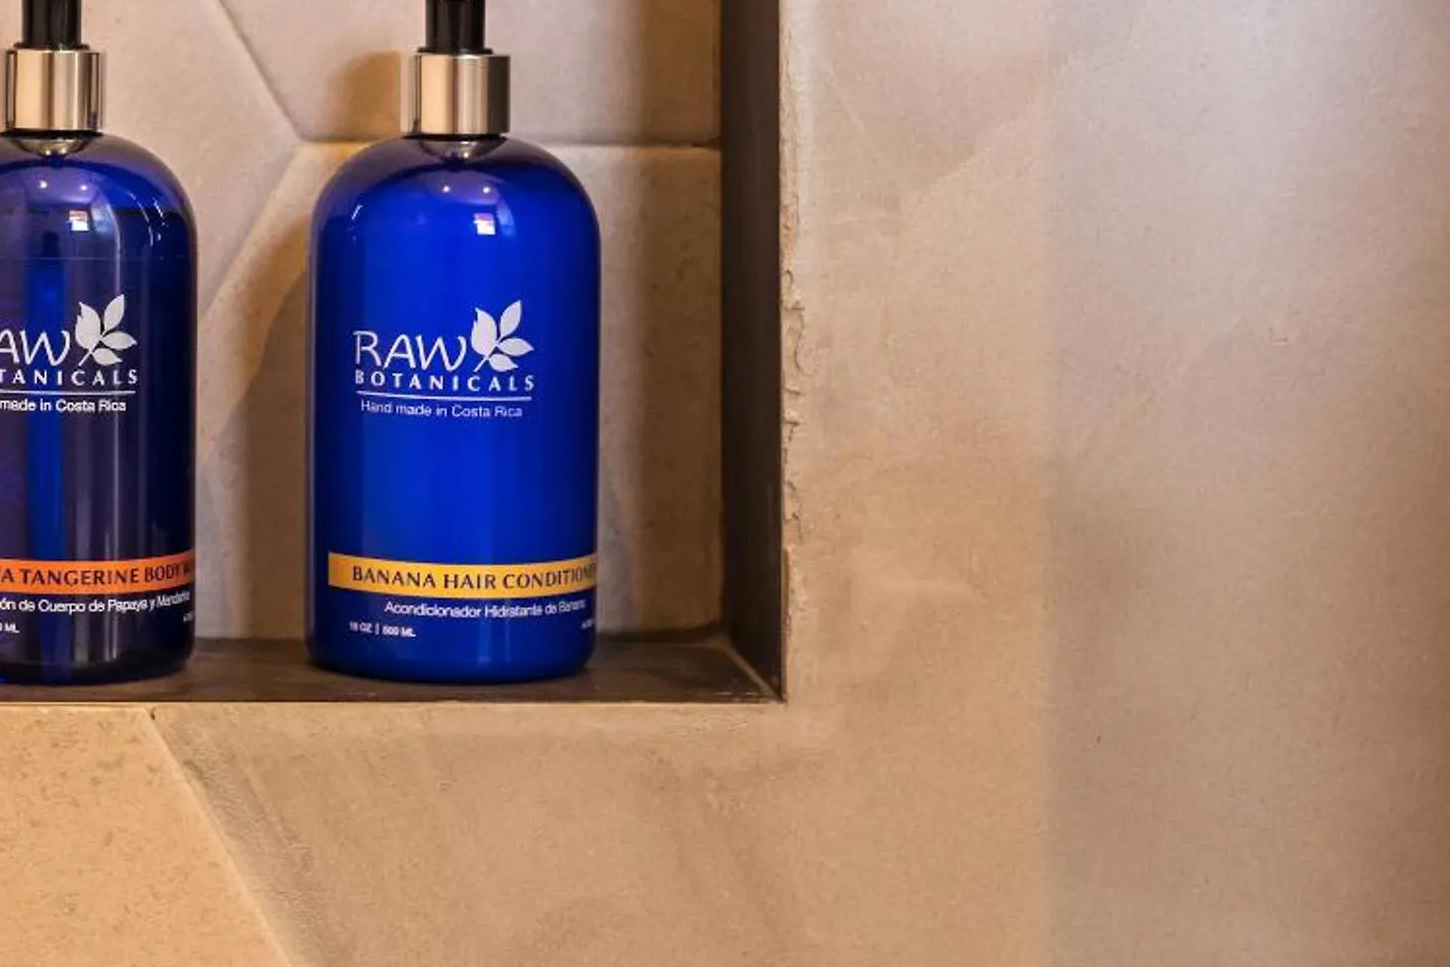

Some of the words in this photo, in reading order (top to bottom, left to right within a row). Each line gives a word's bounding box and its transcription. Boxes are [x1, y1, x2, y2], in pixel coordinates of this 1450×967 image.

[353, 330, 467, 371] RAW
[355, 369, 535, 392] BOTANICALS
[0, 397, 36, 411] made
[40, 398, 52, 411] in
[56, 399, 95, 413] Costa
[100, 400, 127, 412] Rica
[360, 399, 392, 414] Hand
[396, 403, 432, 416] made
[436, 404, 448, 416] in
[452, 404, 491, 418] Costa
[495, 405, 523, 418] Rica
[20, 567, 140, 586] TANGERINE
[352, 565, 436, 588] BANANA
[444, 573, 496, 589] HAIR
[18, 599, 35, 612] de
[38, 599, 86, 615] Cuerpo
[88, 599, 105, 612] de
[107, 599, 148, 613] Papaya
[384, 601, 481, 618] Acondicionador
